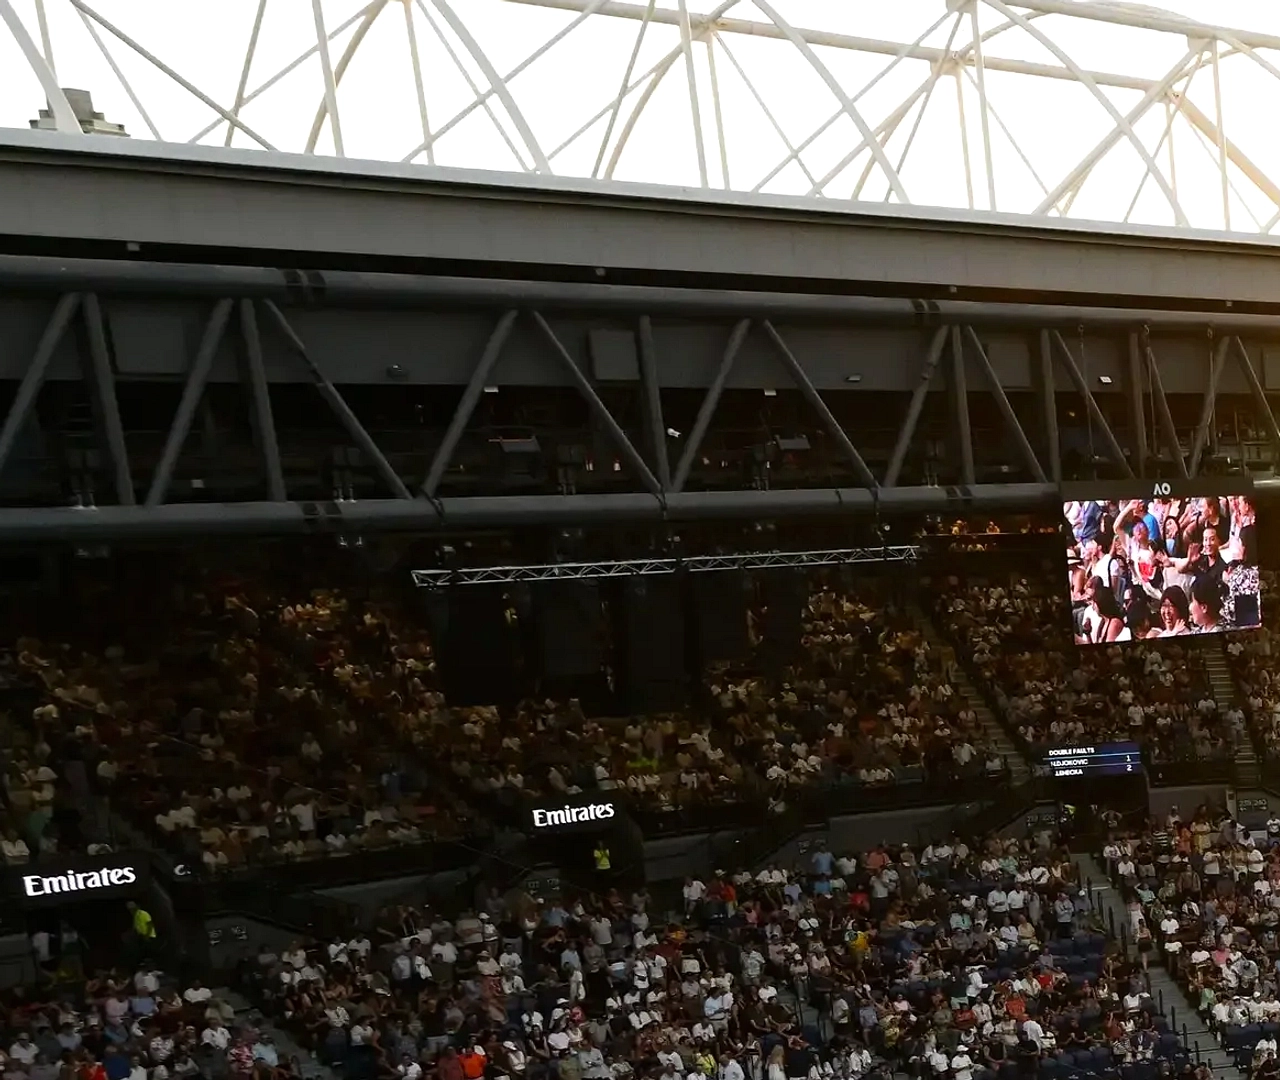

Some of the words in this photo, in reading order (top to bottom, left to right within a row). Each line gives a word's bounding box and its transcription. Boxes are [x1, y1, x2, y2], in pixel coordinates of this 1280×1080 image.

[1153, 483, 1172, 496] AO
[532, 802, 615, 827] Emirates
[22, 865, 137, 898] Emirates
